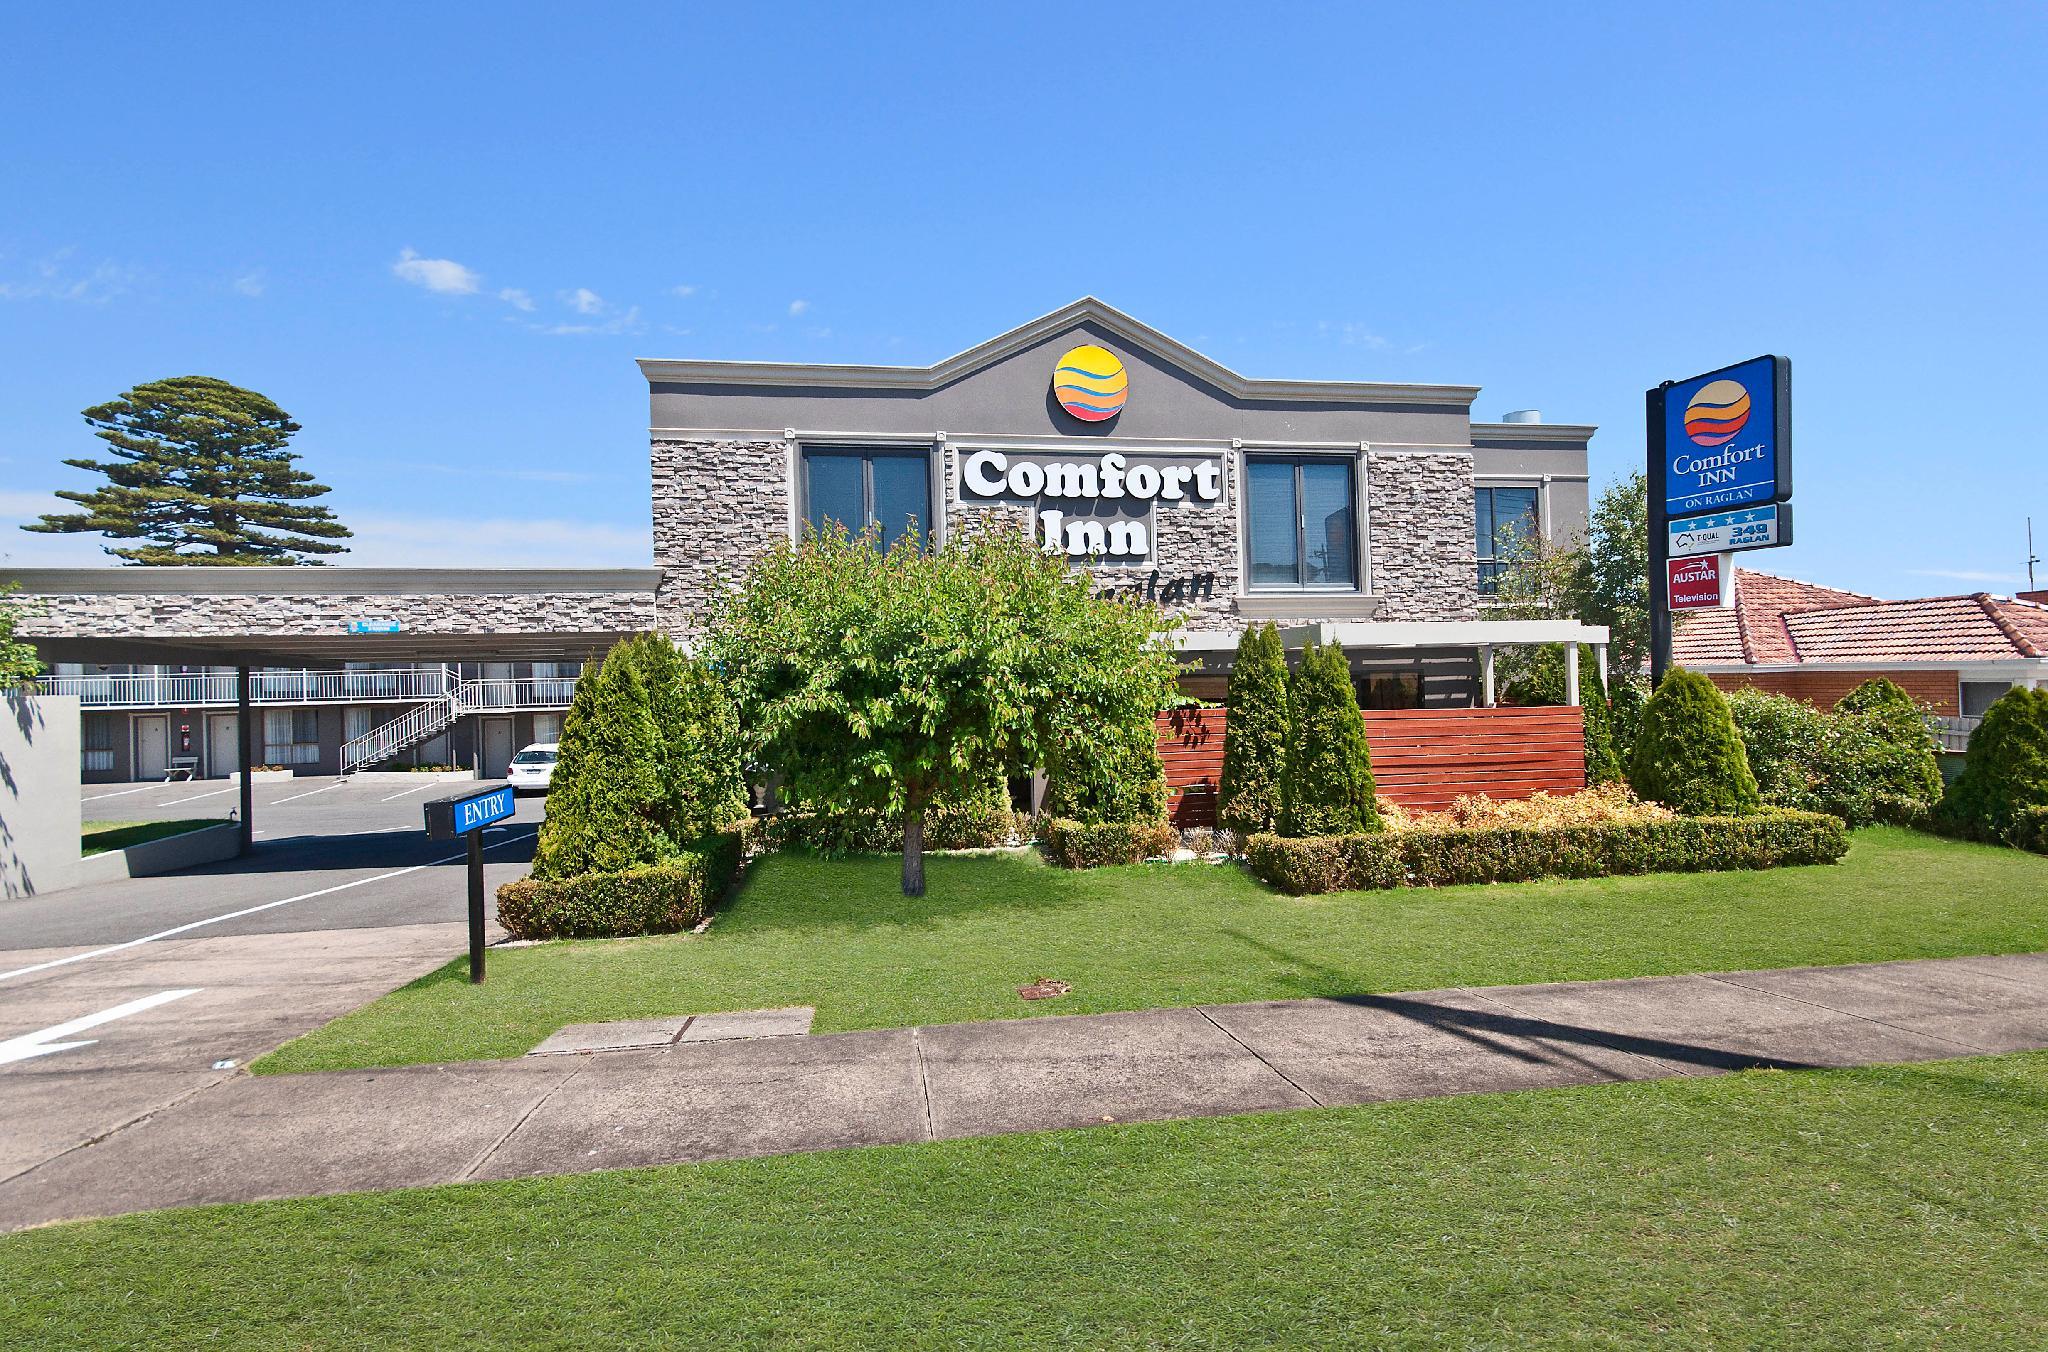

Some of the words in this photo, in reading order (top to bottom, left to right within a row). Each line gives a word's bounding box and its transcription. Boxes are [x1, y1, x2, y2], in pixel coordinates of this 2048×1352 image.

[1672, 443, 1765, 475] Comfort
[963, 449, 1221, 500] Comfort
[1698, 466, 1737, 487] INN
[1685, 498, 1702, 509] ON
[1705, 488, 1754, 505] RAGLAN
[1040, 509, 1149, 556] Inn
[1729, 534, 1770, 546] RAGLAN
[1732, 523, 1768, 538] 349
[1673, 569, 1716, 584] AUSTAR
[1673, 592, 1718, 603] Television
[464, 793, 505, 826] ENTRY
